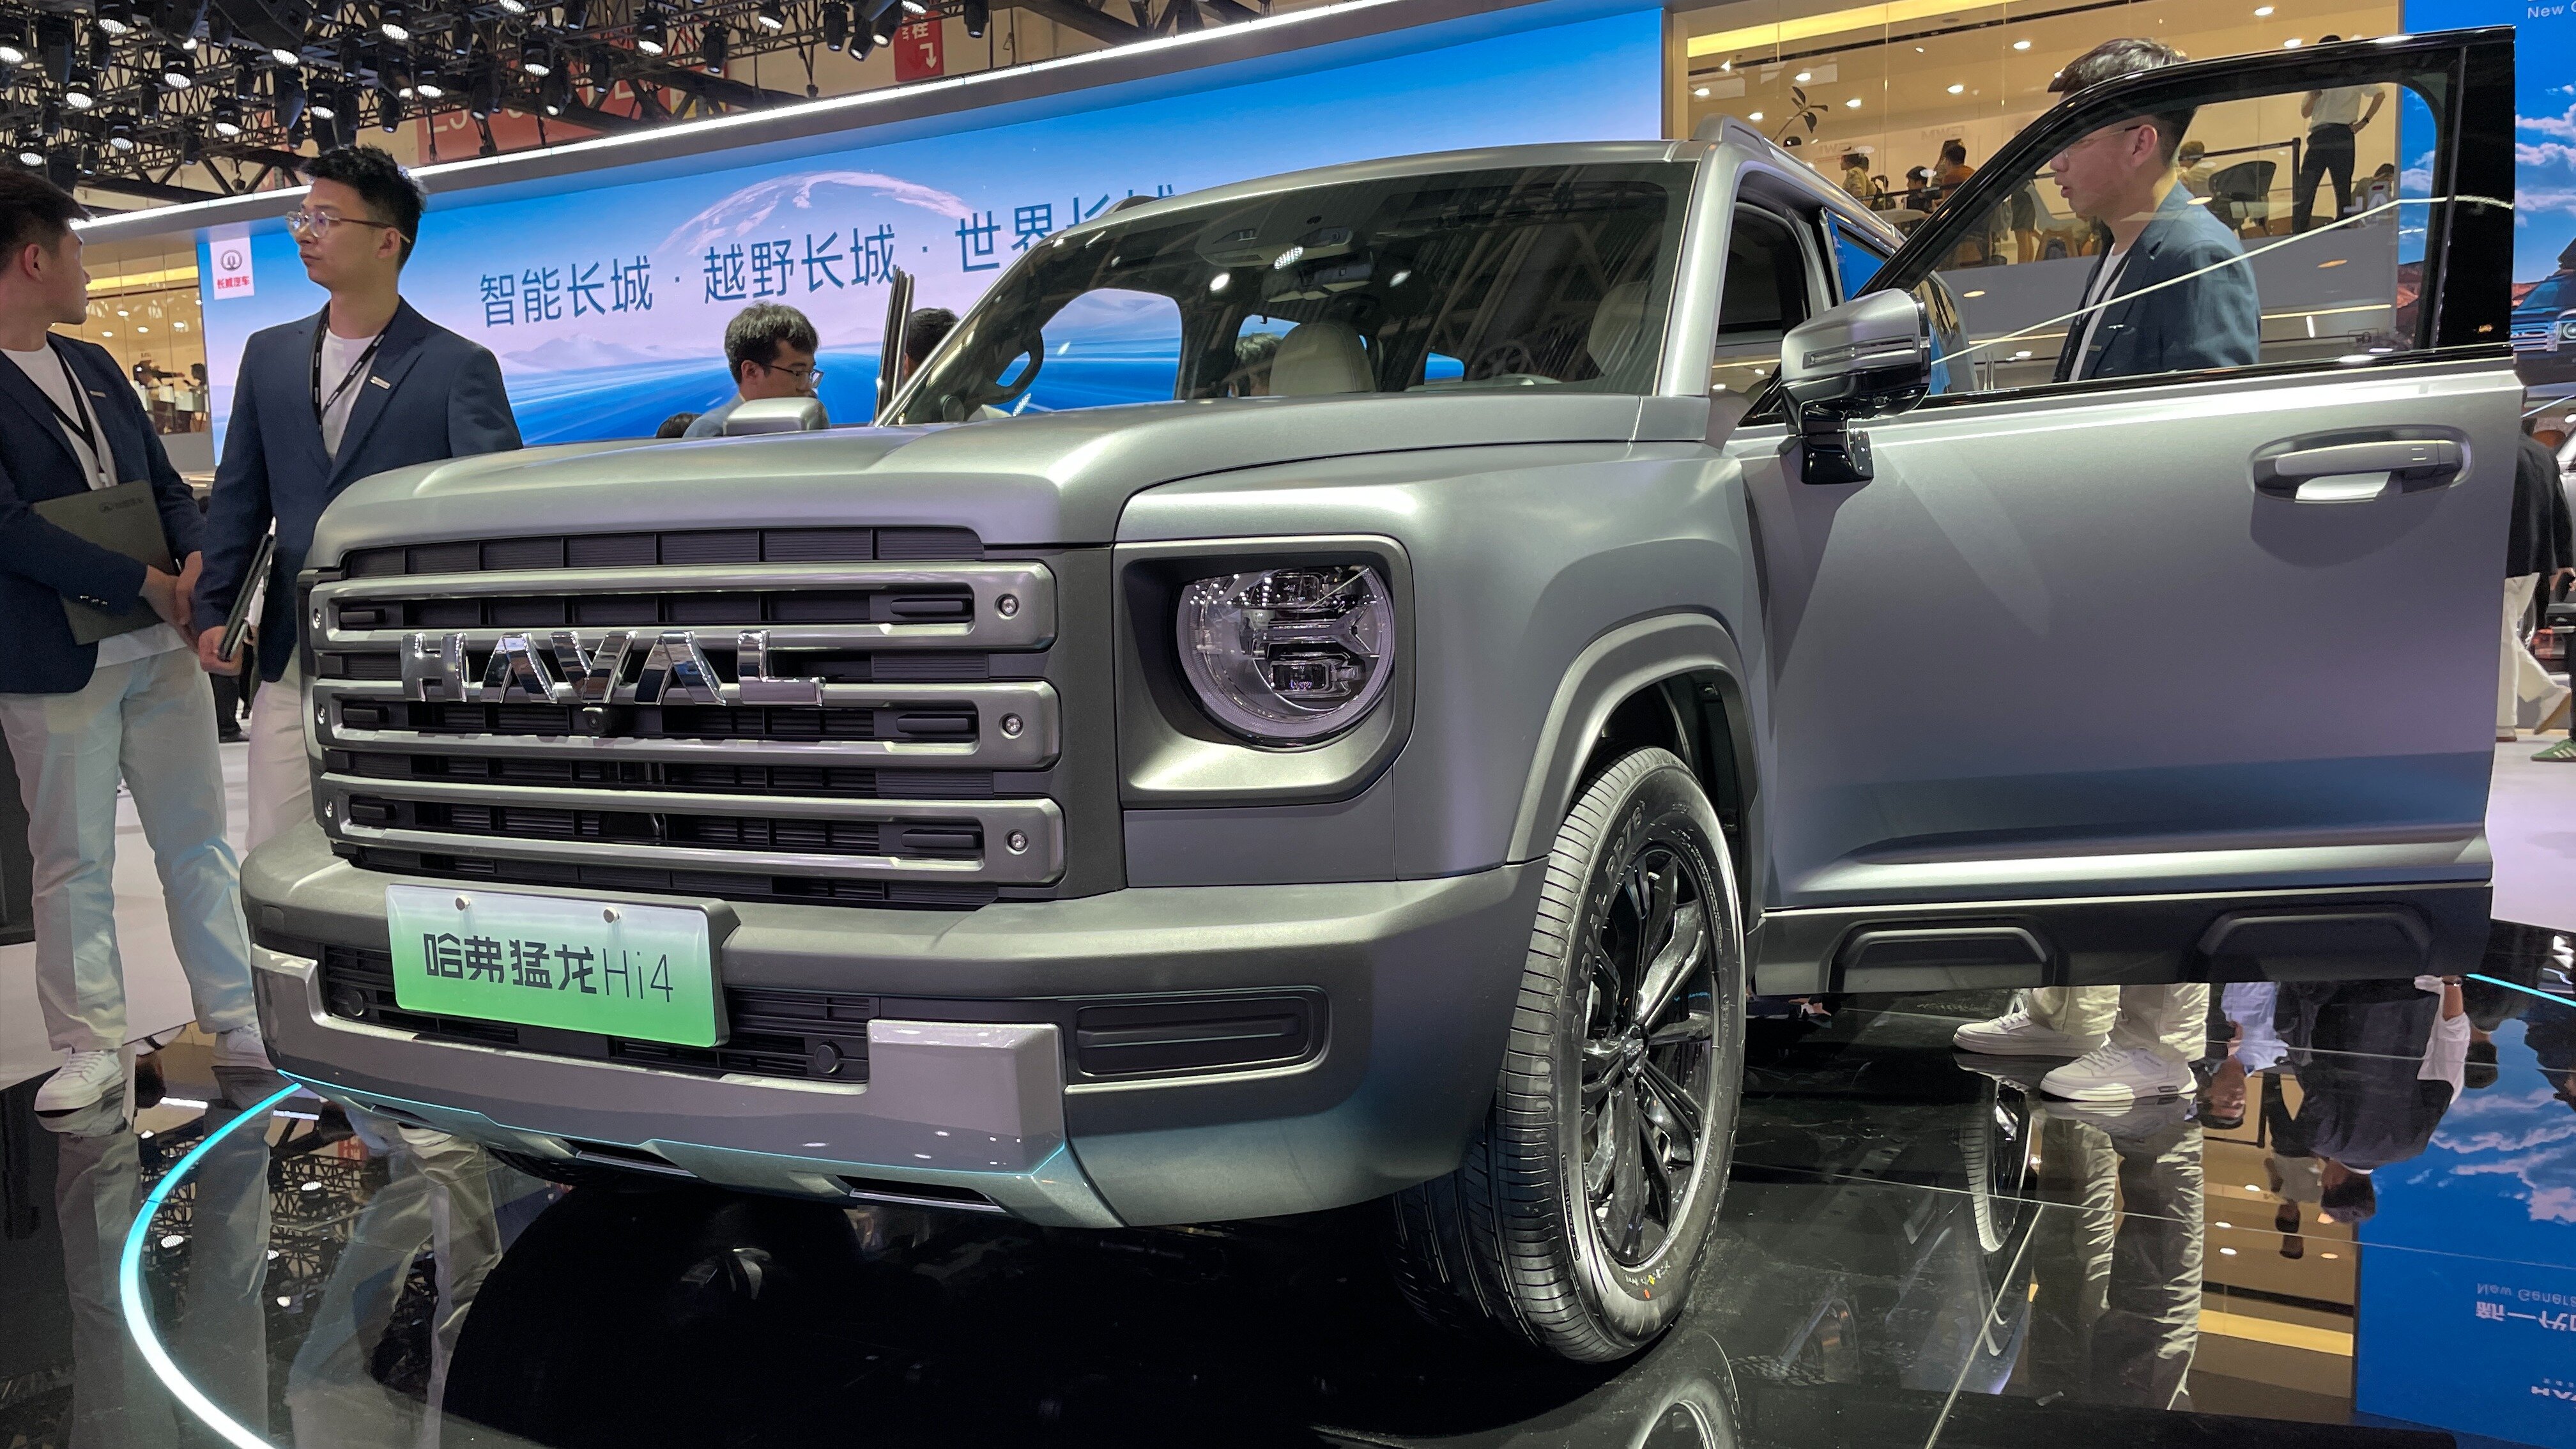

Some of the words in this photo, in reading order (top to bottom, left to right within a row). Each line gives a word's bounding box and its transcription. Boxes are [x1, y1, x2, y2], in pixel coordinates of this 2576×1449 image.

[2527, 4, 2564, 19] New
[479, 256, 653, 328] 智能长城
[703, 223, 898, 304] 越野长城
[400, 629, 824, 707] HAVAL
[423, 932, 673, 1002] 哈弗猛龙Hi4
